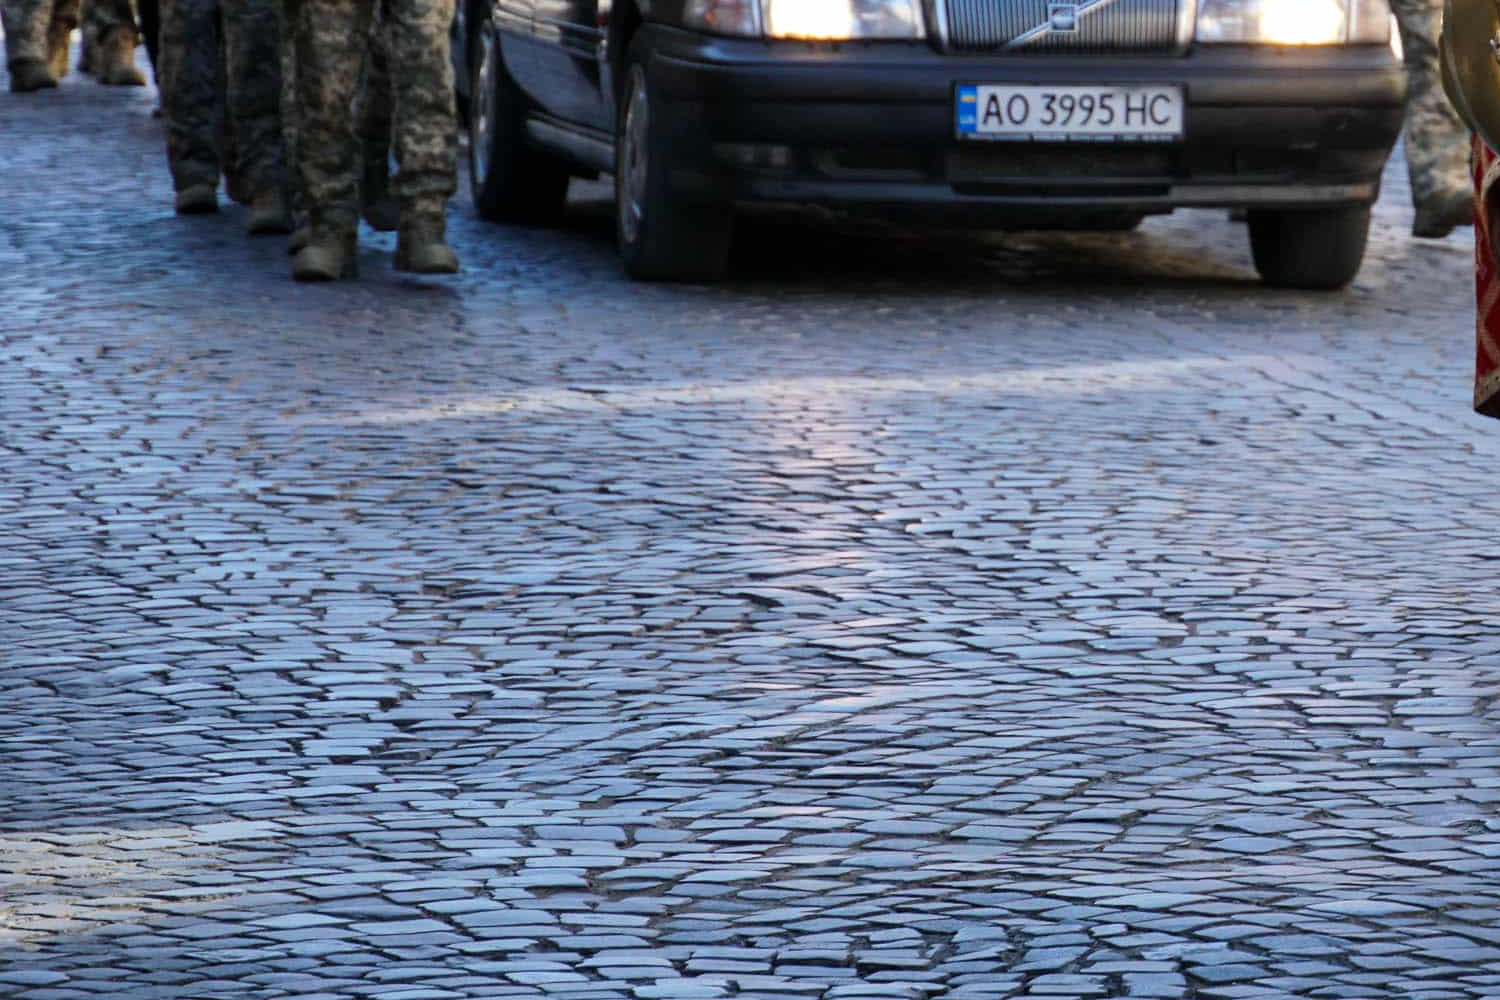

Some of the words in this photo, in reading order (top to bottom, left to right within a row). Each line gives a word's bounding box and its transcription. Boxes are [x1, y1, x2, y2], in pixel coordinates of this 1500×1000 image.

[982, 93, 1030, 126] AO
[1040, 93, 1115, 126] 3995
[1125, 93, 1170, 126] HC
